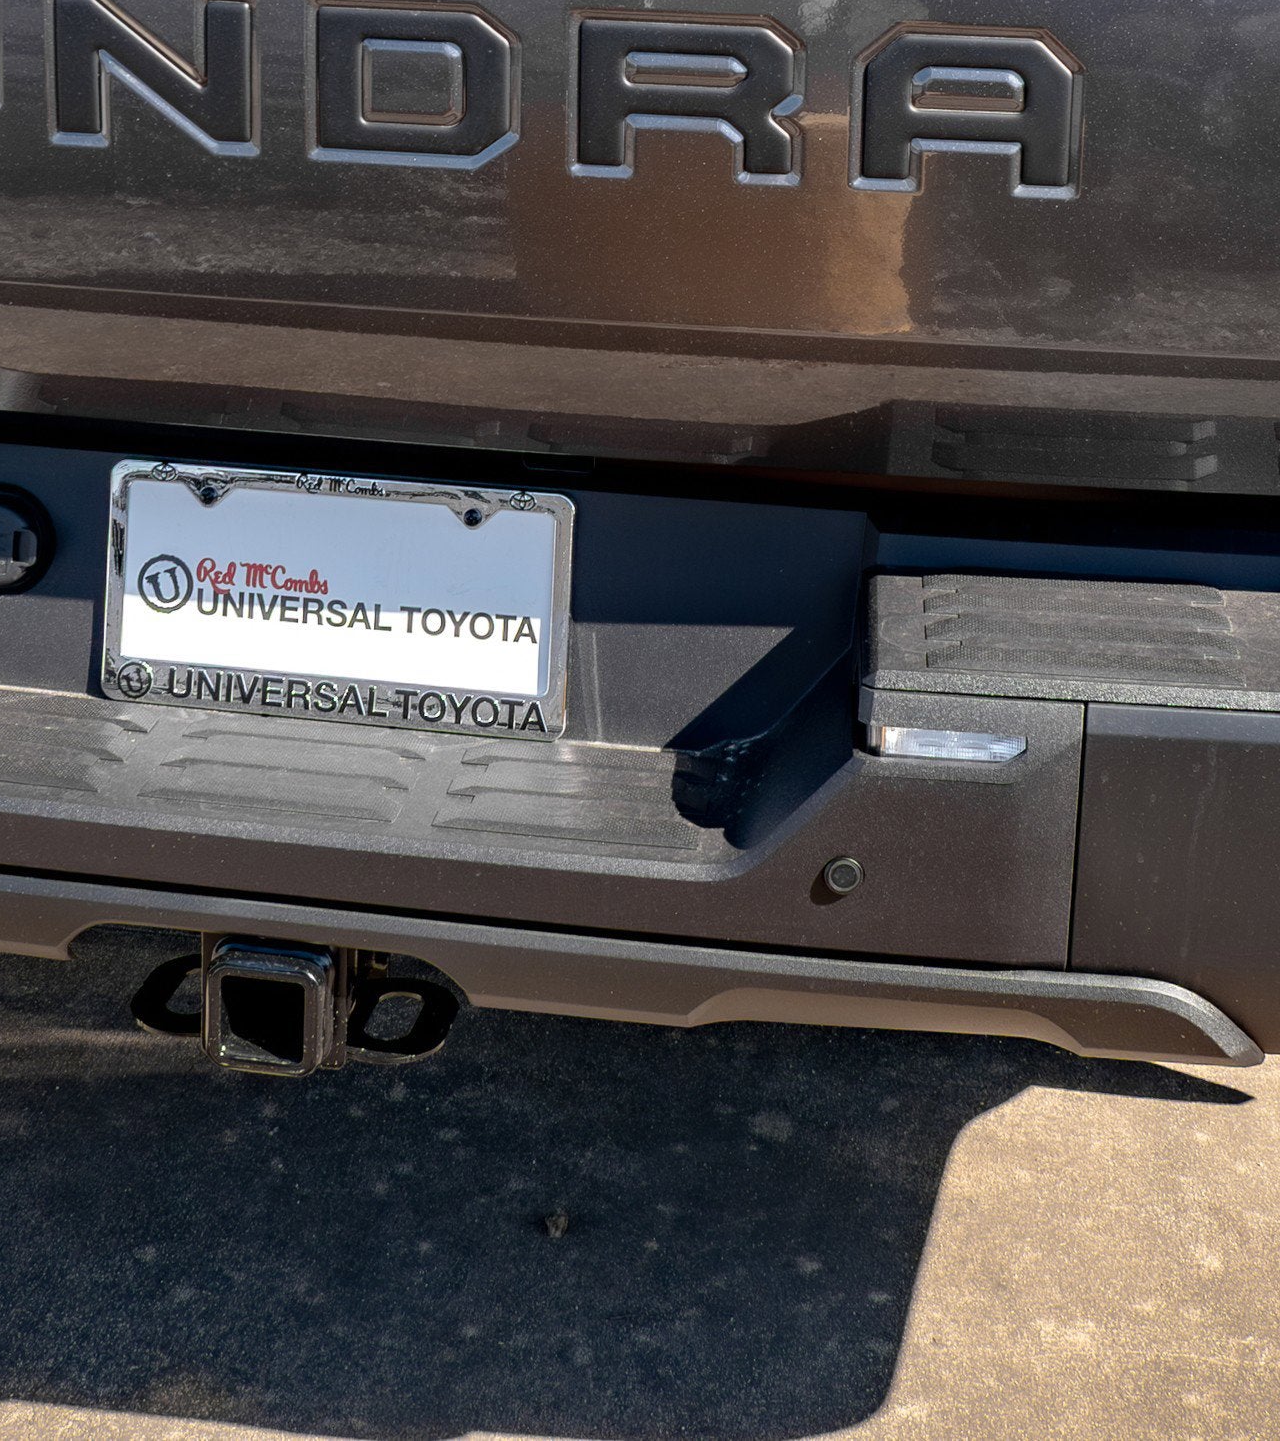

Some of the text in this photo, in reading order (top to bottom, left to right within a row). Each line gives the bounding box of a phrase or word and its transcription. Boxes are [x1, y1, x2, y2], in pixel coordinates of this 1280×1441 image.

[296, 472, 385, 497] Red McCombs
[197, 558, 329, 596] Red McCombs
[197, 588, 538, 644] UNIVERSAL TOYOTA
[168, 666, 389, 718] UNIVERSAL
[395, 687, 549, 733] TOYOTA
